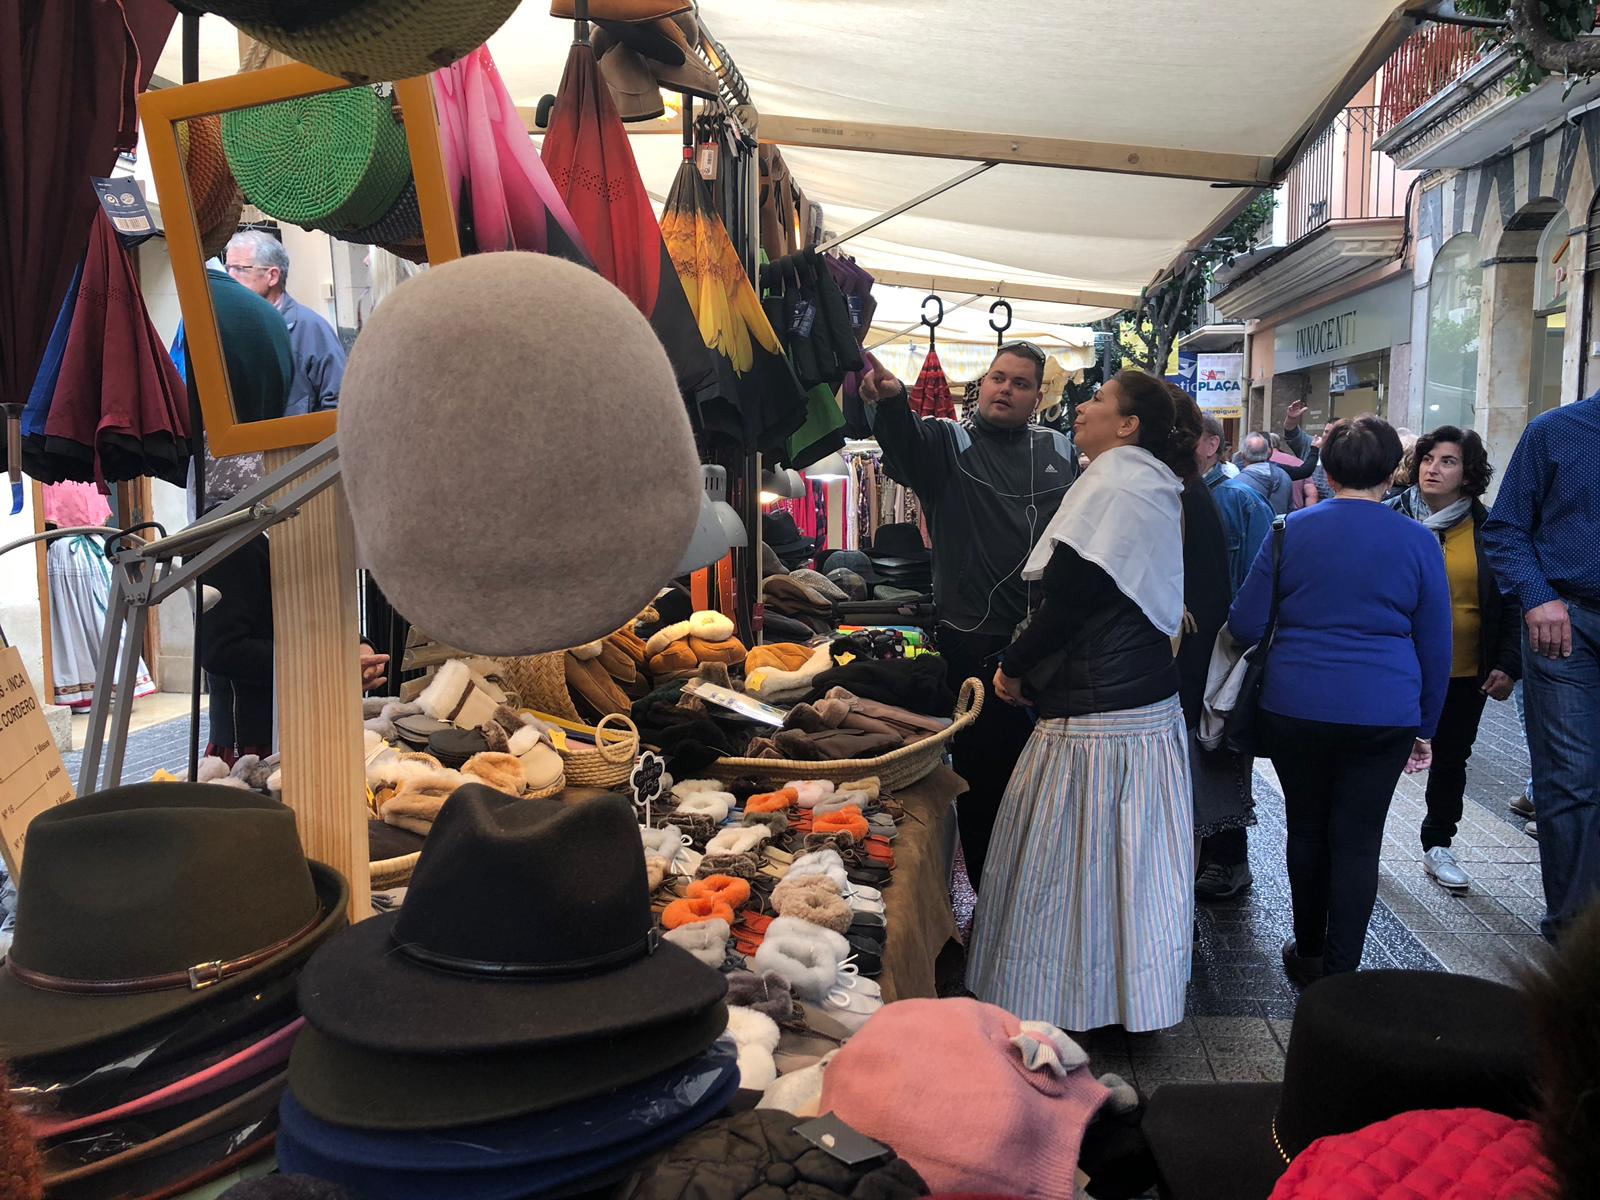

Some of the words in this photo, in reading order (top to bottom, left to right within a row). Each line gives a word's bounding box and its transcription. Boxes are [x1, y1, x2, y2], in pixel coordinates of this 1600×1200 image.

[1296, 310, 1357, 359] INNOCENTI
[1198, 380, 1241, 392] PLAÇA
[7, 672, 26, 692] INCA
[1, 696, 36, 728] CORDERO
